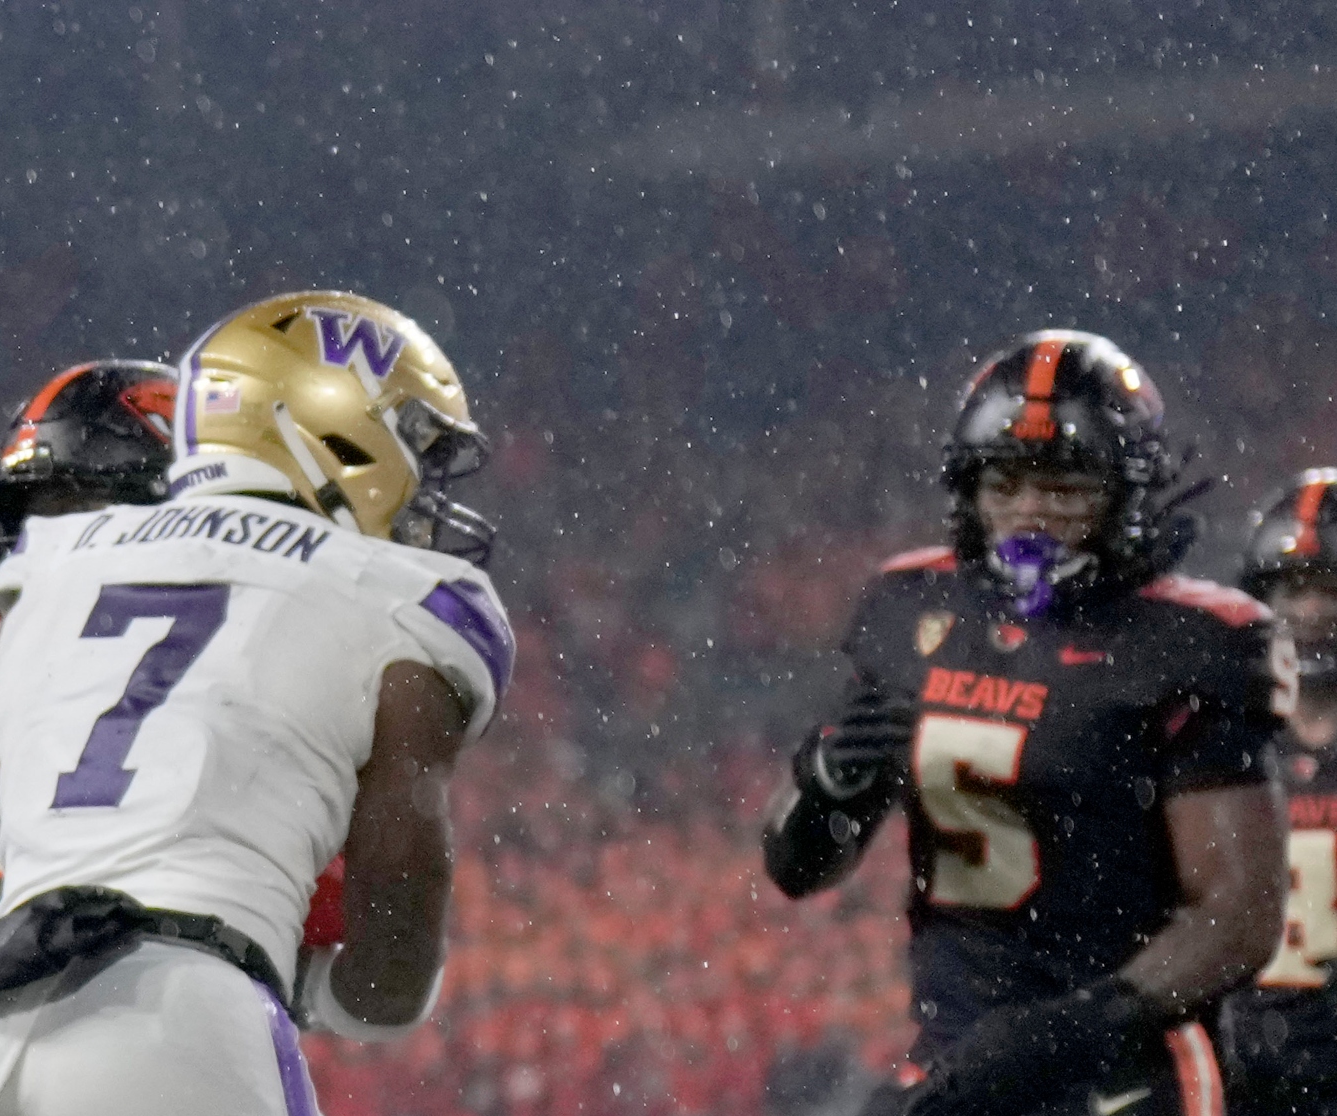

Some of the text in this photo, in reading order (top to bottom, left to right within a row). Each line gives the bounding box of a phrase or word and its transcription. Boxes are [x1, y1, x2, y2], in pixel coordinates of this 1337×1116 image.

[304, 306, 408, 381] W
[114, 506, 331, 564] JOHNSON
[48, 583, 232, 810] 7
[922, 667, 1049, 720] BEAVS
[915, 711, 1041, 909] 5
